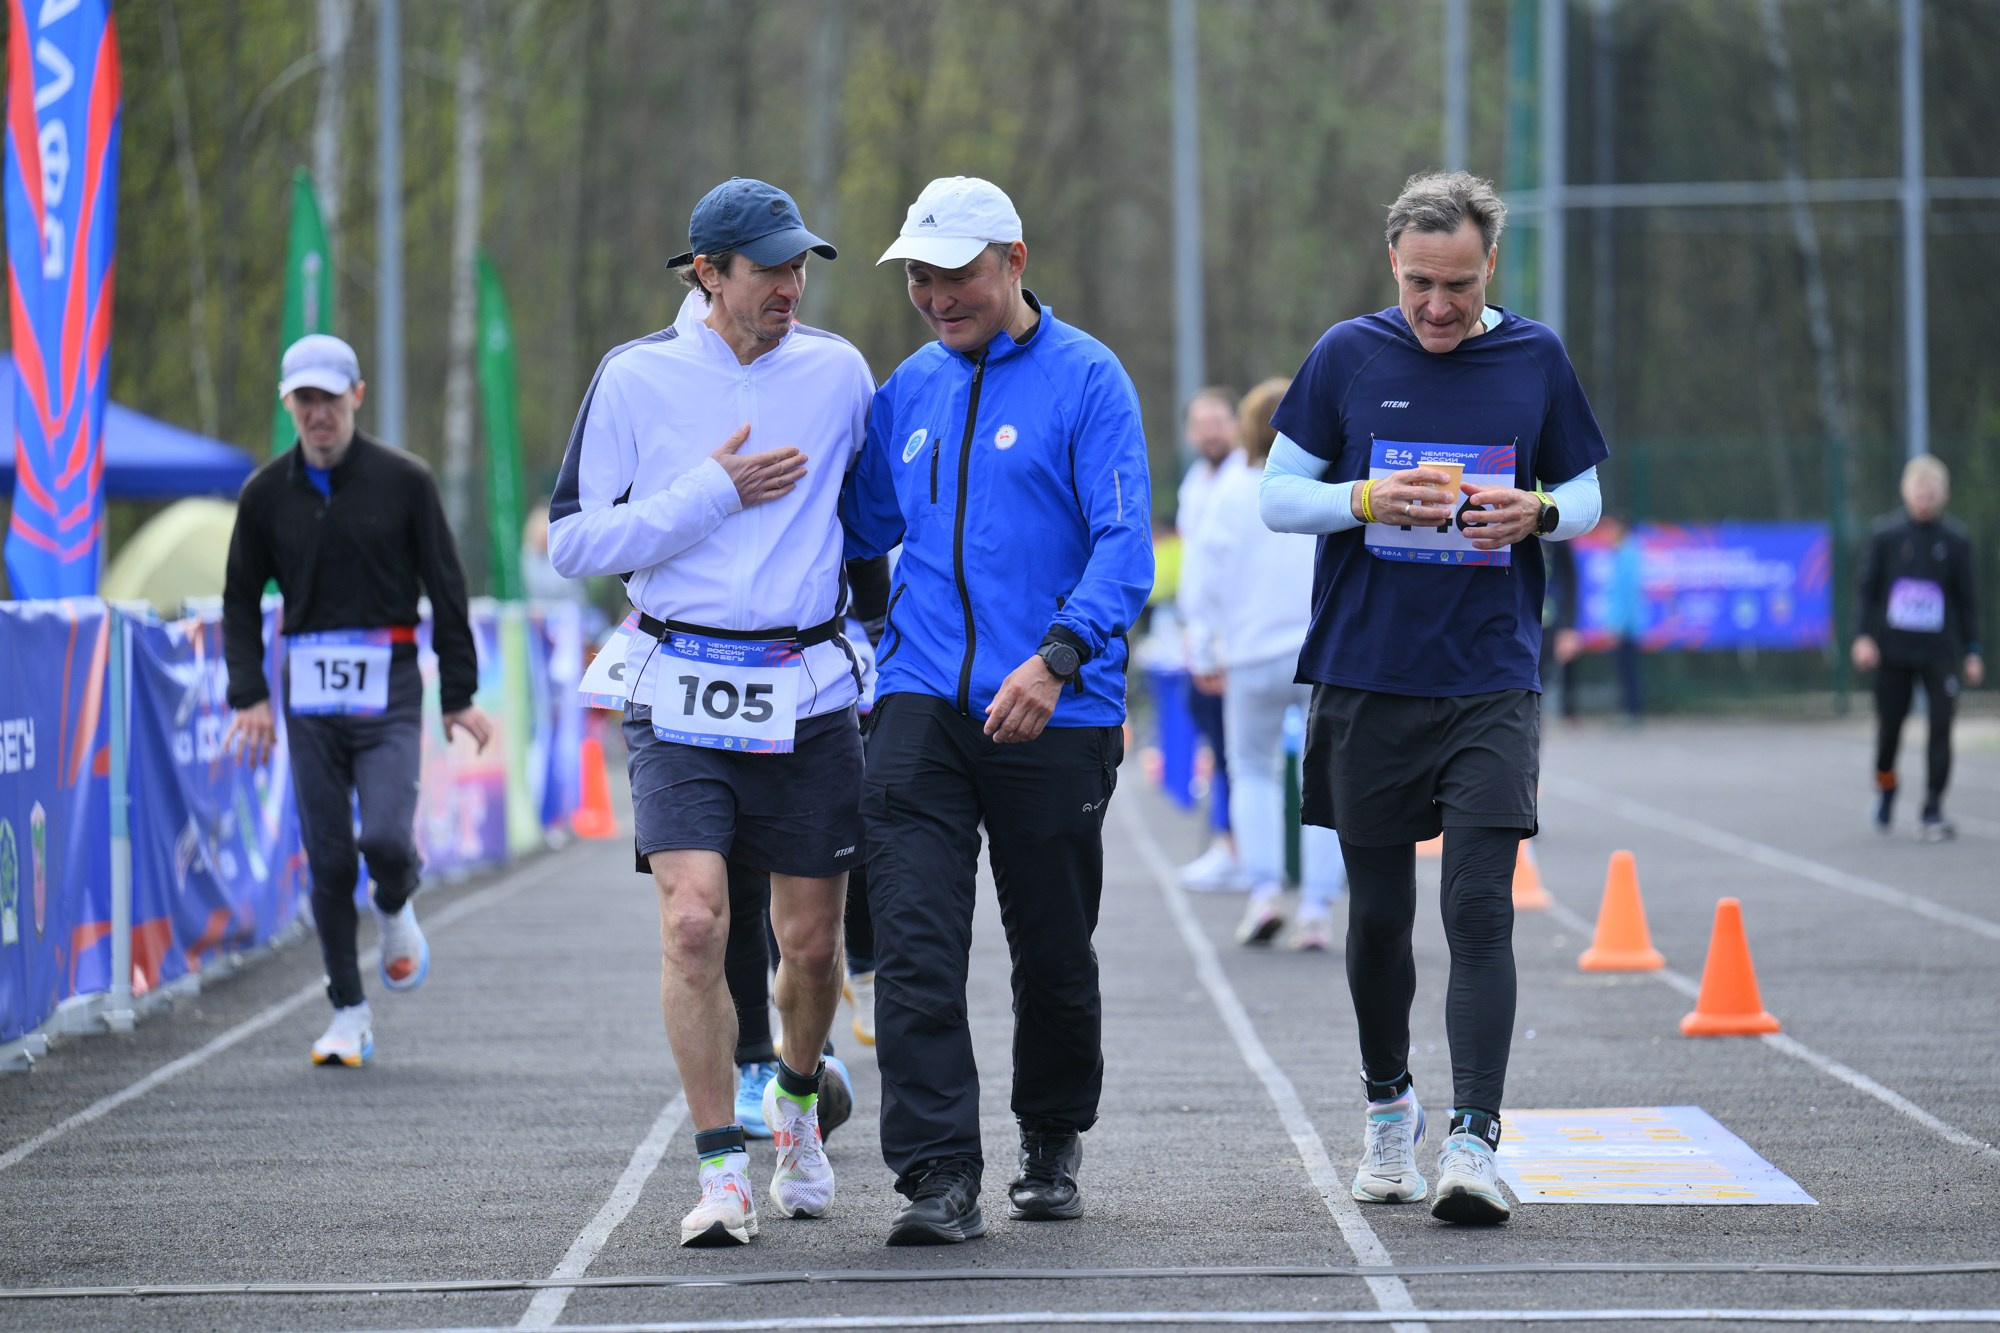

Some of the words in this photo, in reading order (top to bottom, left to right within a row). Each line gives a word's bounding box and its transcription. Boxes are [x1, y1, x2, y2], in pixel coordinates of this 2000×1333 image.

[1385, 448, 1413, 460] 24
[1384, 458, 1413, 466] ЧАСА
[674, 638, 700, 650] 24
[707, 642, 767, 652] ЧЕМПИОНАТ
[674, 647, 700, 657] ЧАСА
[706, 647, 745, 656] РОССИИ
[314, 660, 368, 691] 151
[678, 675, 774, 723] 105
